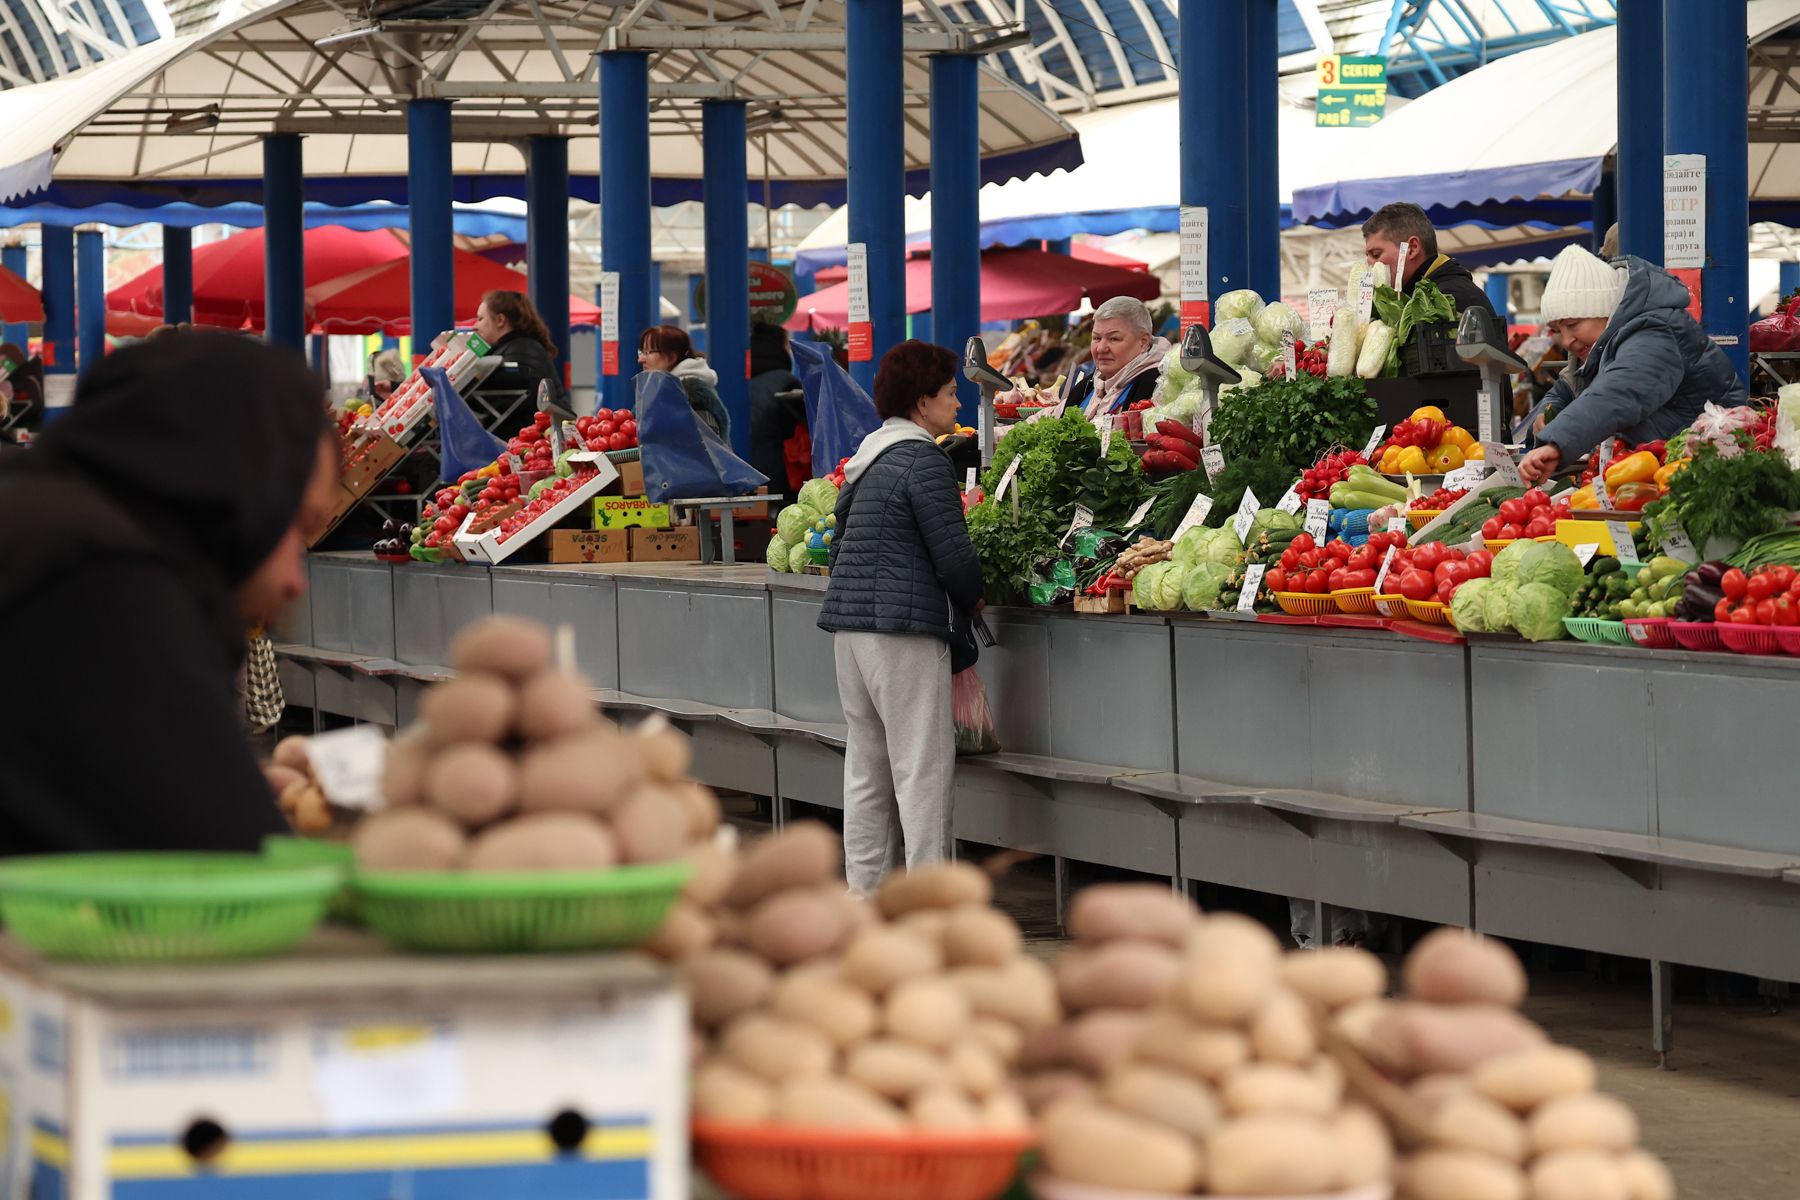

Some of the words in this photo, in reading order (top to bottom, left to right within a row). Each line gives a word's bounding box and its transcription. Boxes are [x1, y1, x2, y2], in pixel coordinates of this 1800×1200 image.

[1322, 61, 1335, 84] 3
[1342, 64, 1384, 78] СЕКТОР
[1353, 94, 1376, 107] РЯД
[1375, 88, 1387, 106] 5
[1317, 112, 1340, 125] РЯД
[1340, 108, 1351, 125] 6
